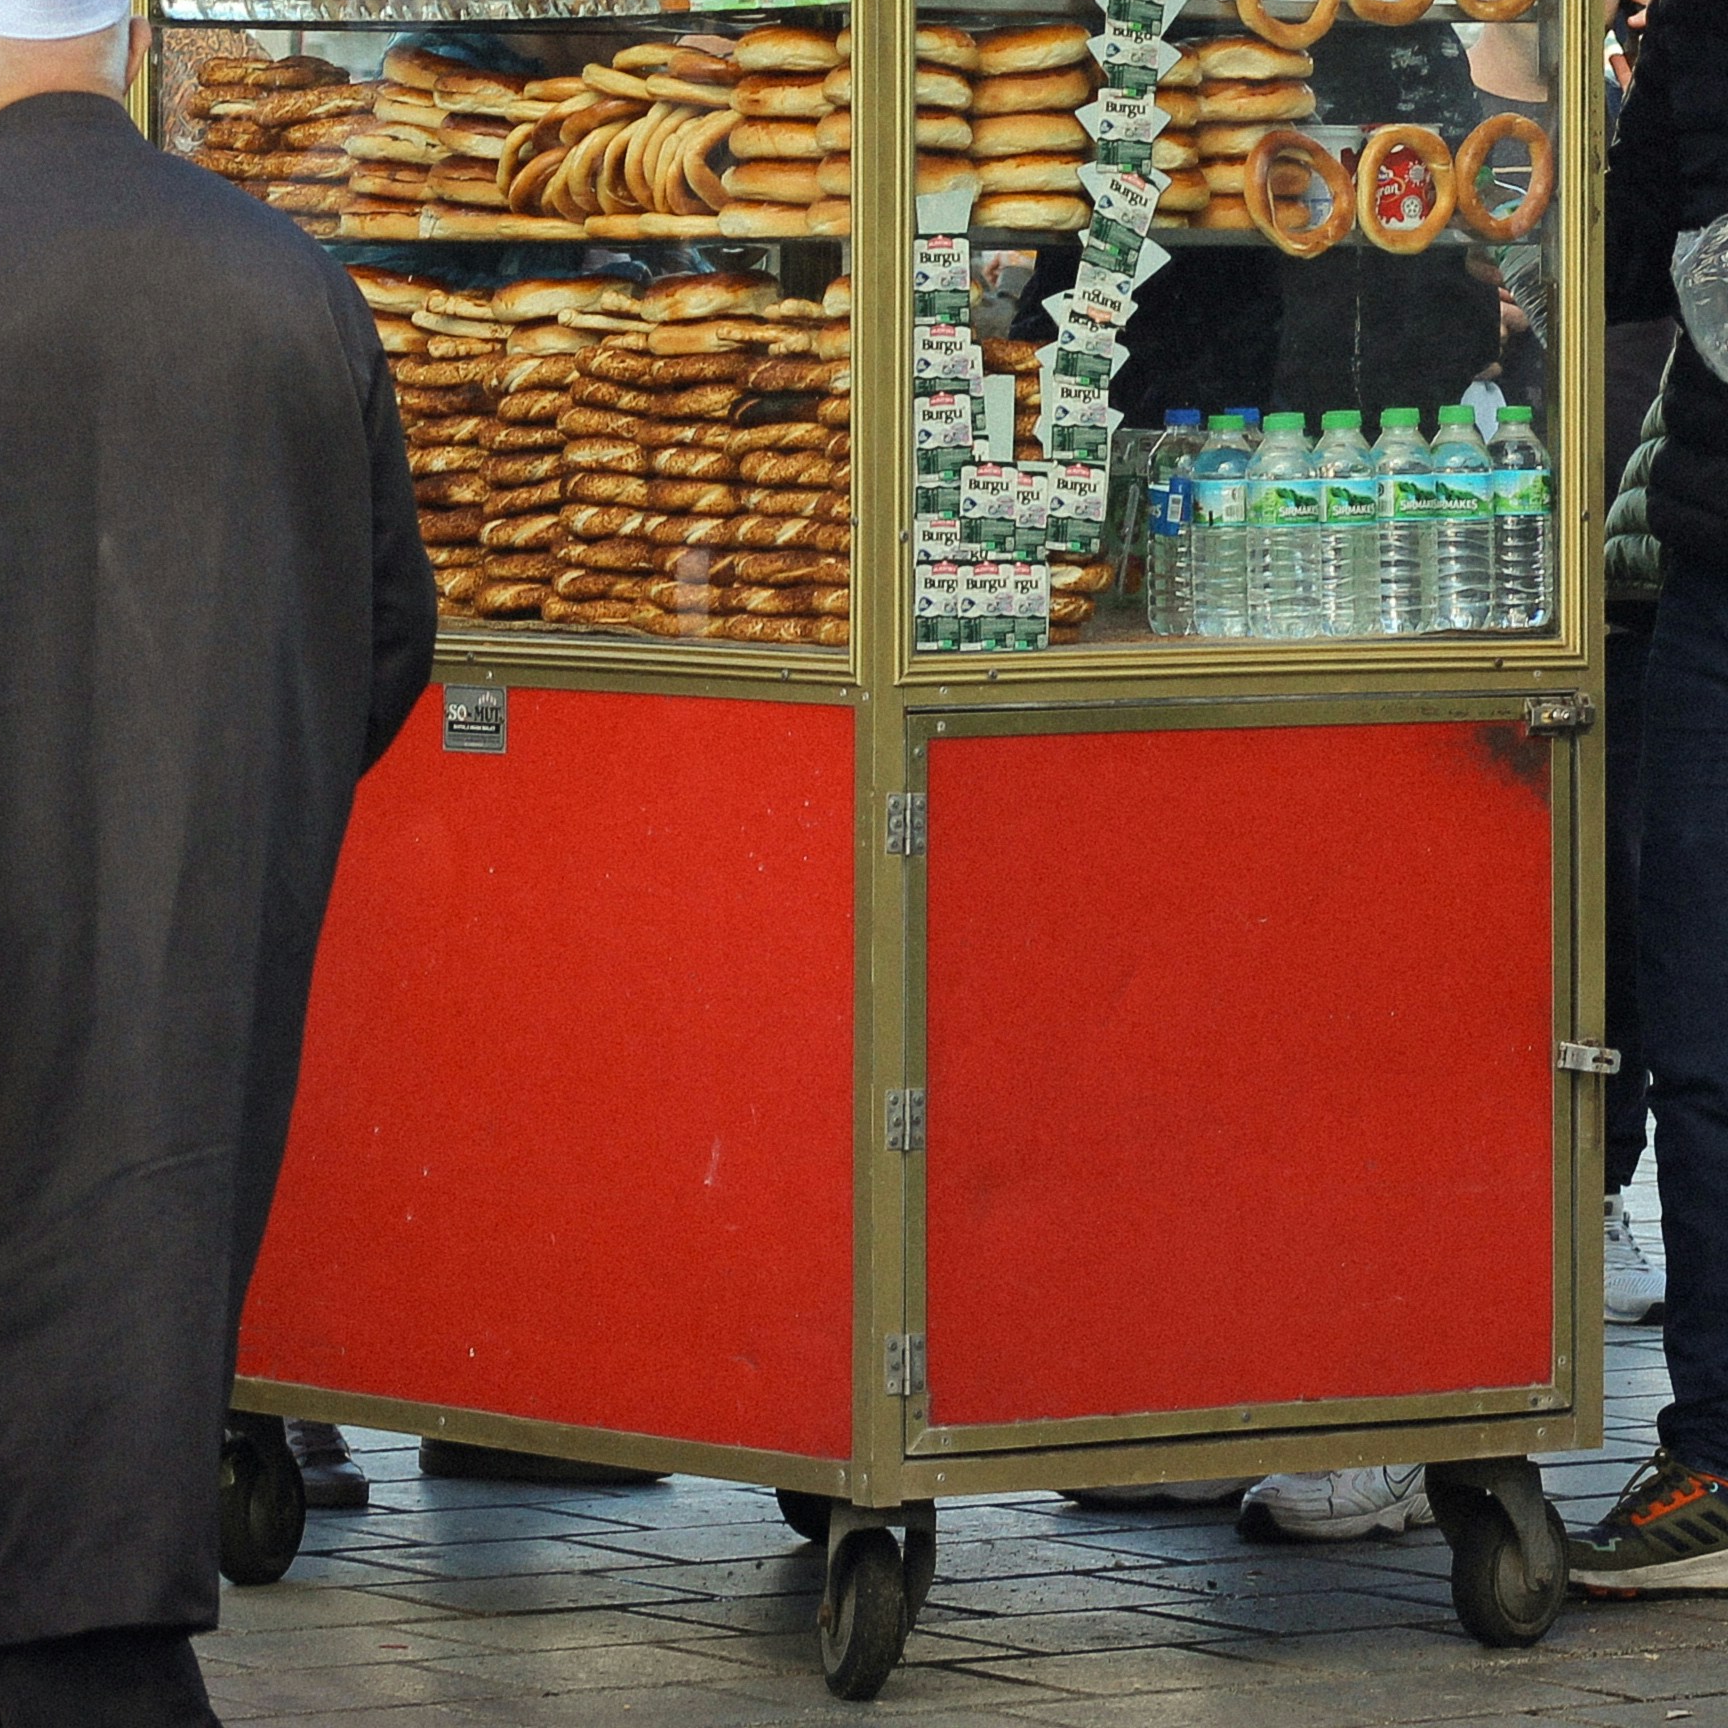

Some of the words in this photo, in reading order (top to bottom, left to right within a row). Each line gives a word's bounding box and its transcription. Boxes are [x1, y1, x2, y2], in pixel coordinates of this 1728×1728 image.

[1105, 100, 1147, 119] Burgu
[1108, 178, 1149, 208] Burgu
[920, 252, 962, 268] Burgu
[1082, 289, 1123, 313] Burgu
[922, 338, 963, 355] Burgu
[1060, 386, 1101, 404] Burgu
[922, 408, 963, 424] Burgu
[968, 478, 1010, 496] Burgu
[1056, 477, 1097, 497] Burgu
[1016, 489, 1041, 506] rgu
[966, 577, 1008, 594] Burgu
[1014, 579, 1040, 594] rgu
